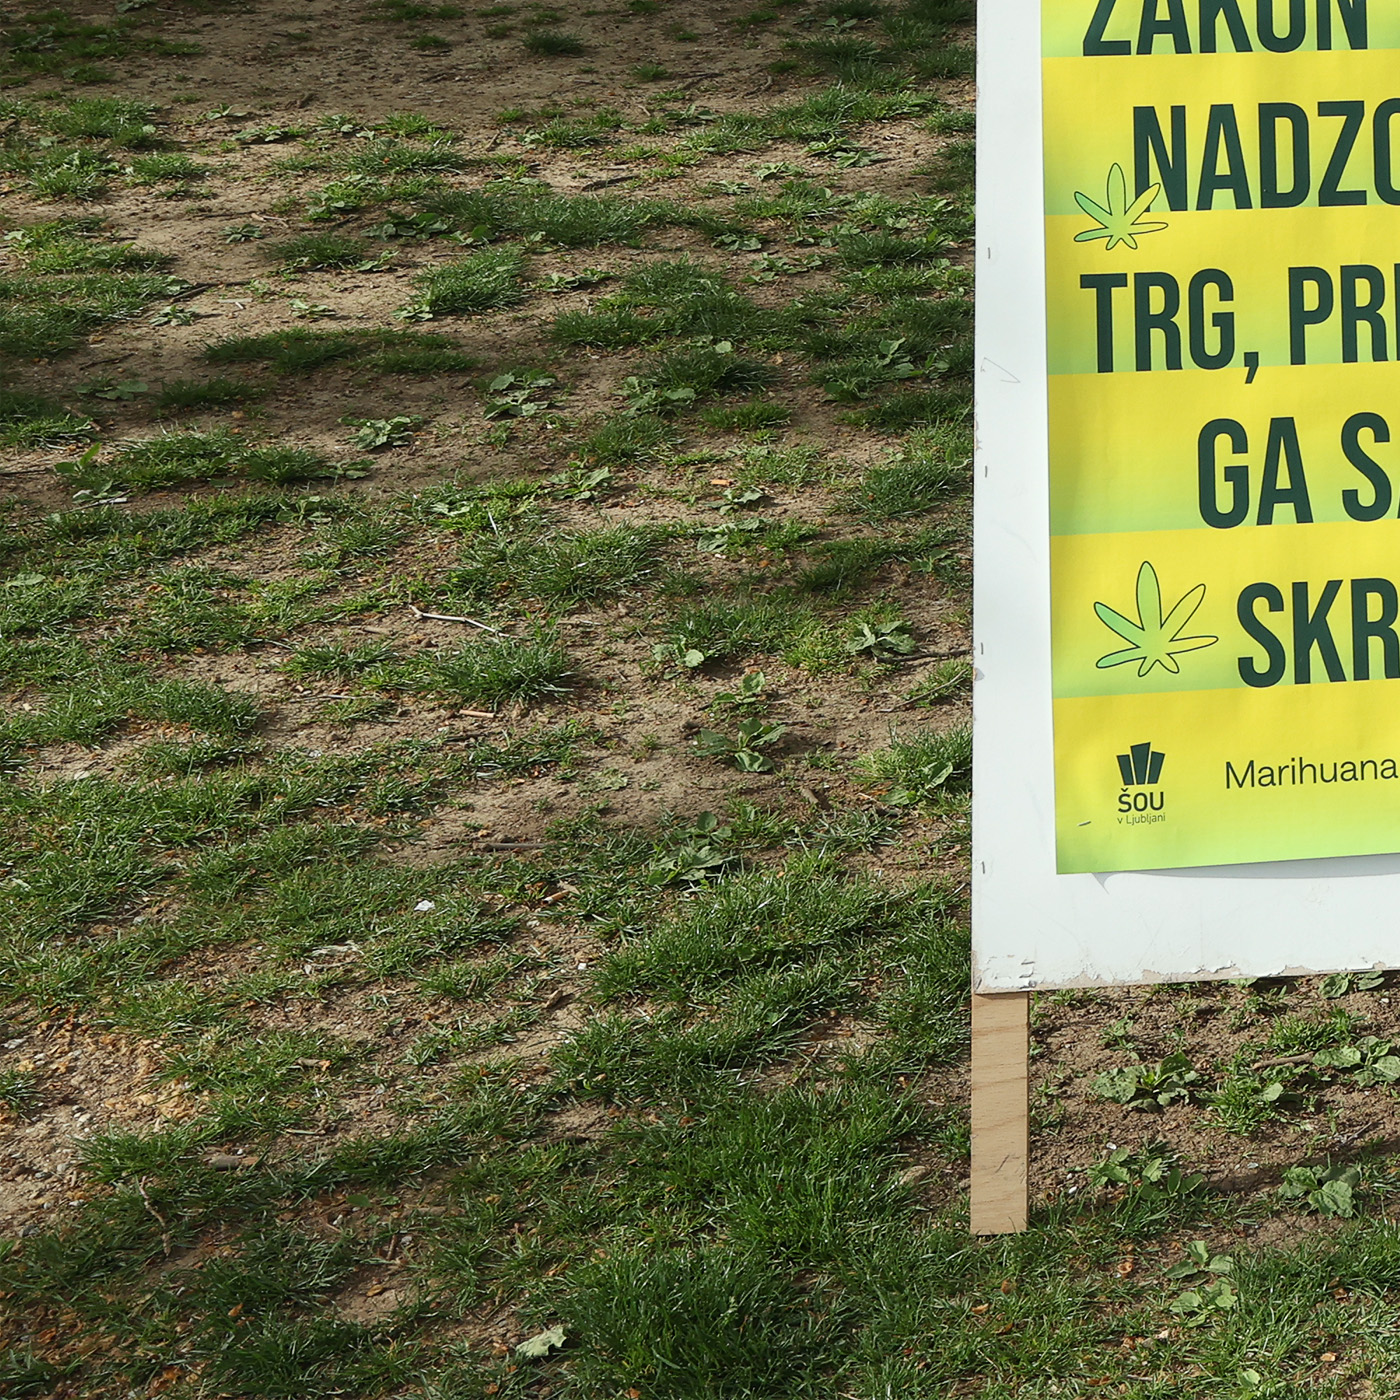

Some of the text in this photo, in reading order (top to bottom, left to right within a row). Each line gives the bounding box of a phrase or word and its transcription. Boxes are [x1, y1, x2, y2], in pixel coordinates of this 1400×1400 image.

[1080, 269, 1259, 384] TRG,
[1197, 417, 1313, 529] GA
[1226, 757, 1398, 789] Marihuana
[1118, 788, 1164, 813] ŠOU
[1126, 812, 1166, 826] Ljubljani
